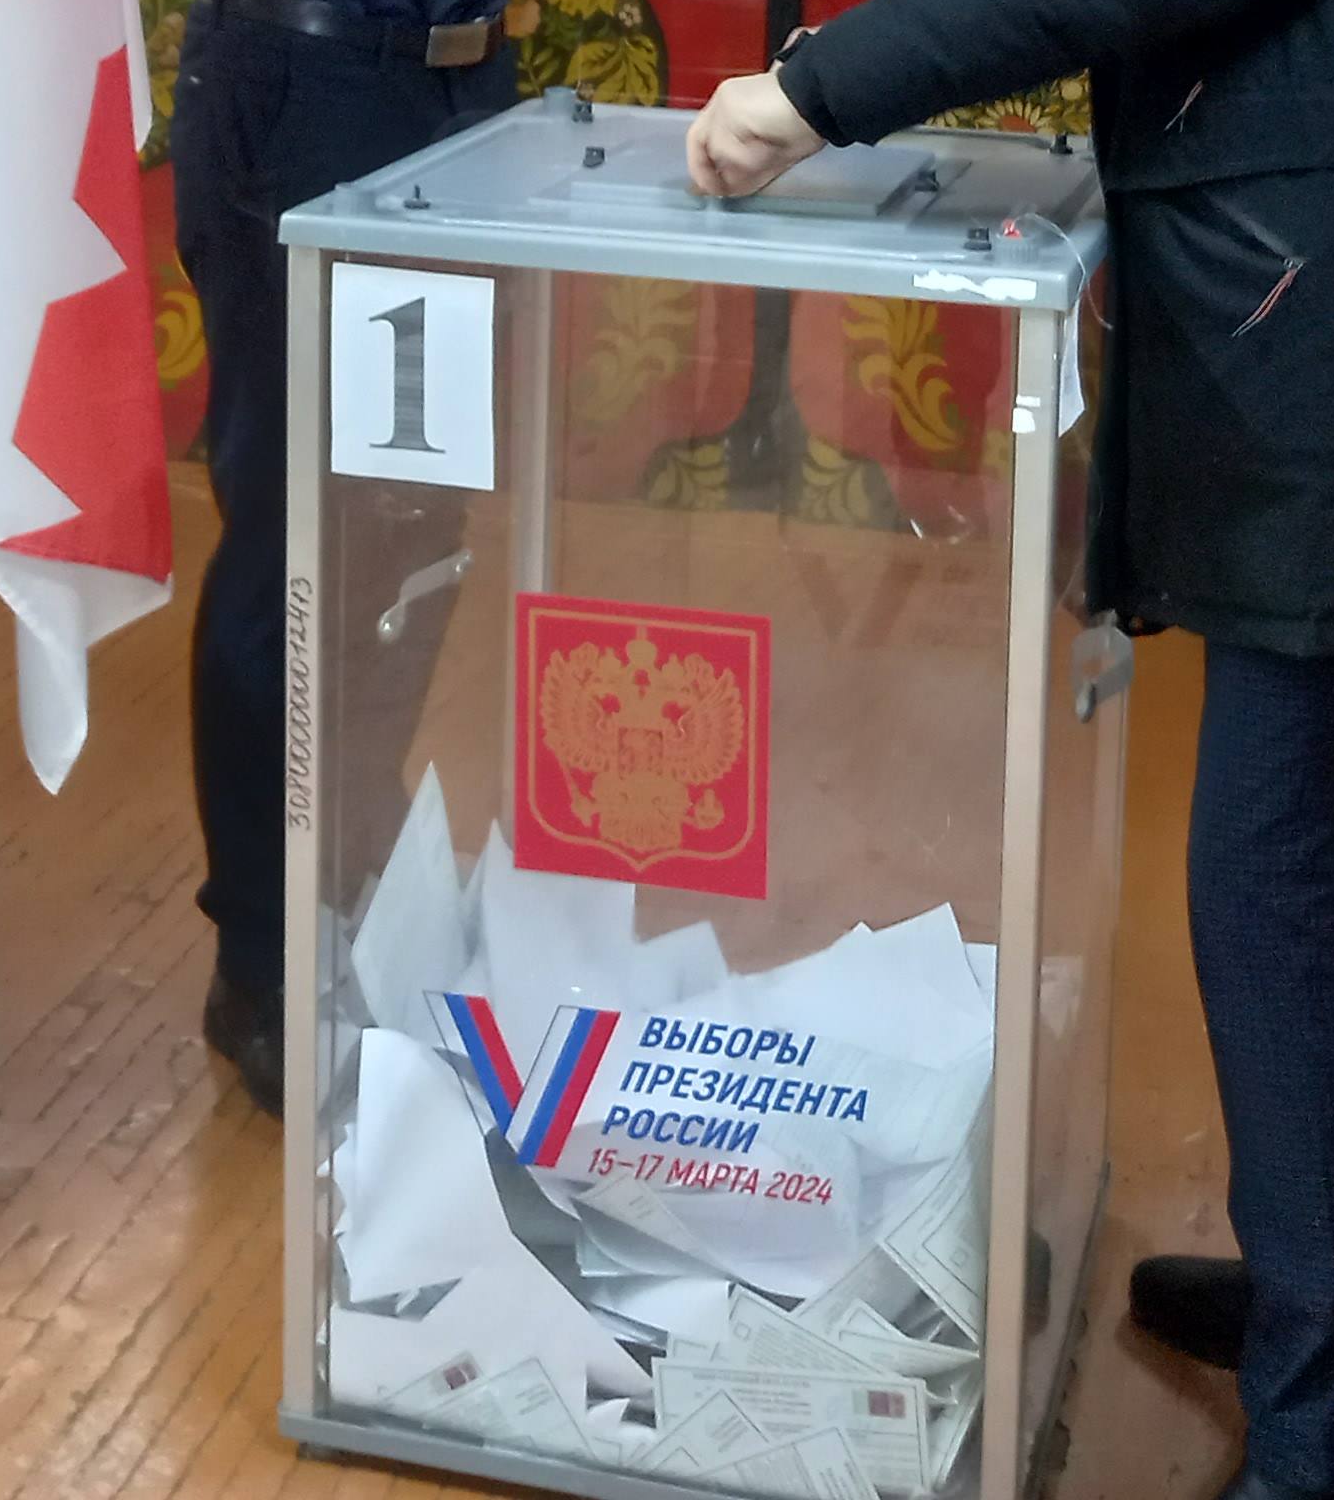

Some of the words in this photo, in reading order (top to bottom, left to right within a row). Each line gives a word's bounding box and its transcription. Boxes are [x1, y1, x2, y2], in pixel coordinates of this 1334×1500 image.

[369, 296, 446, 454] 1
[640, 1016, 816, 1067] ВЫБОРЫ
[620, 1061, 868, 1122] ПРЕЗИДЕНТА
[601, 1105, 760, 1153] РОССИИ
[666, 1158, 760, 1195] МАРТА
[764, 1171, 833, 1205] 2024
